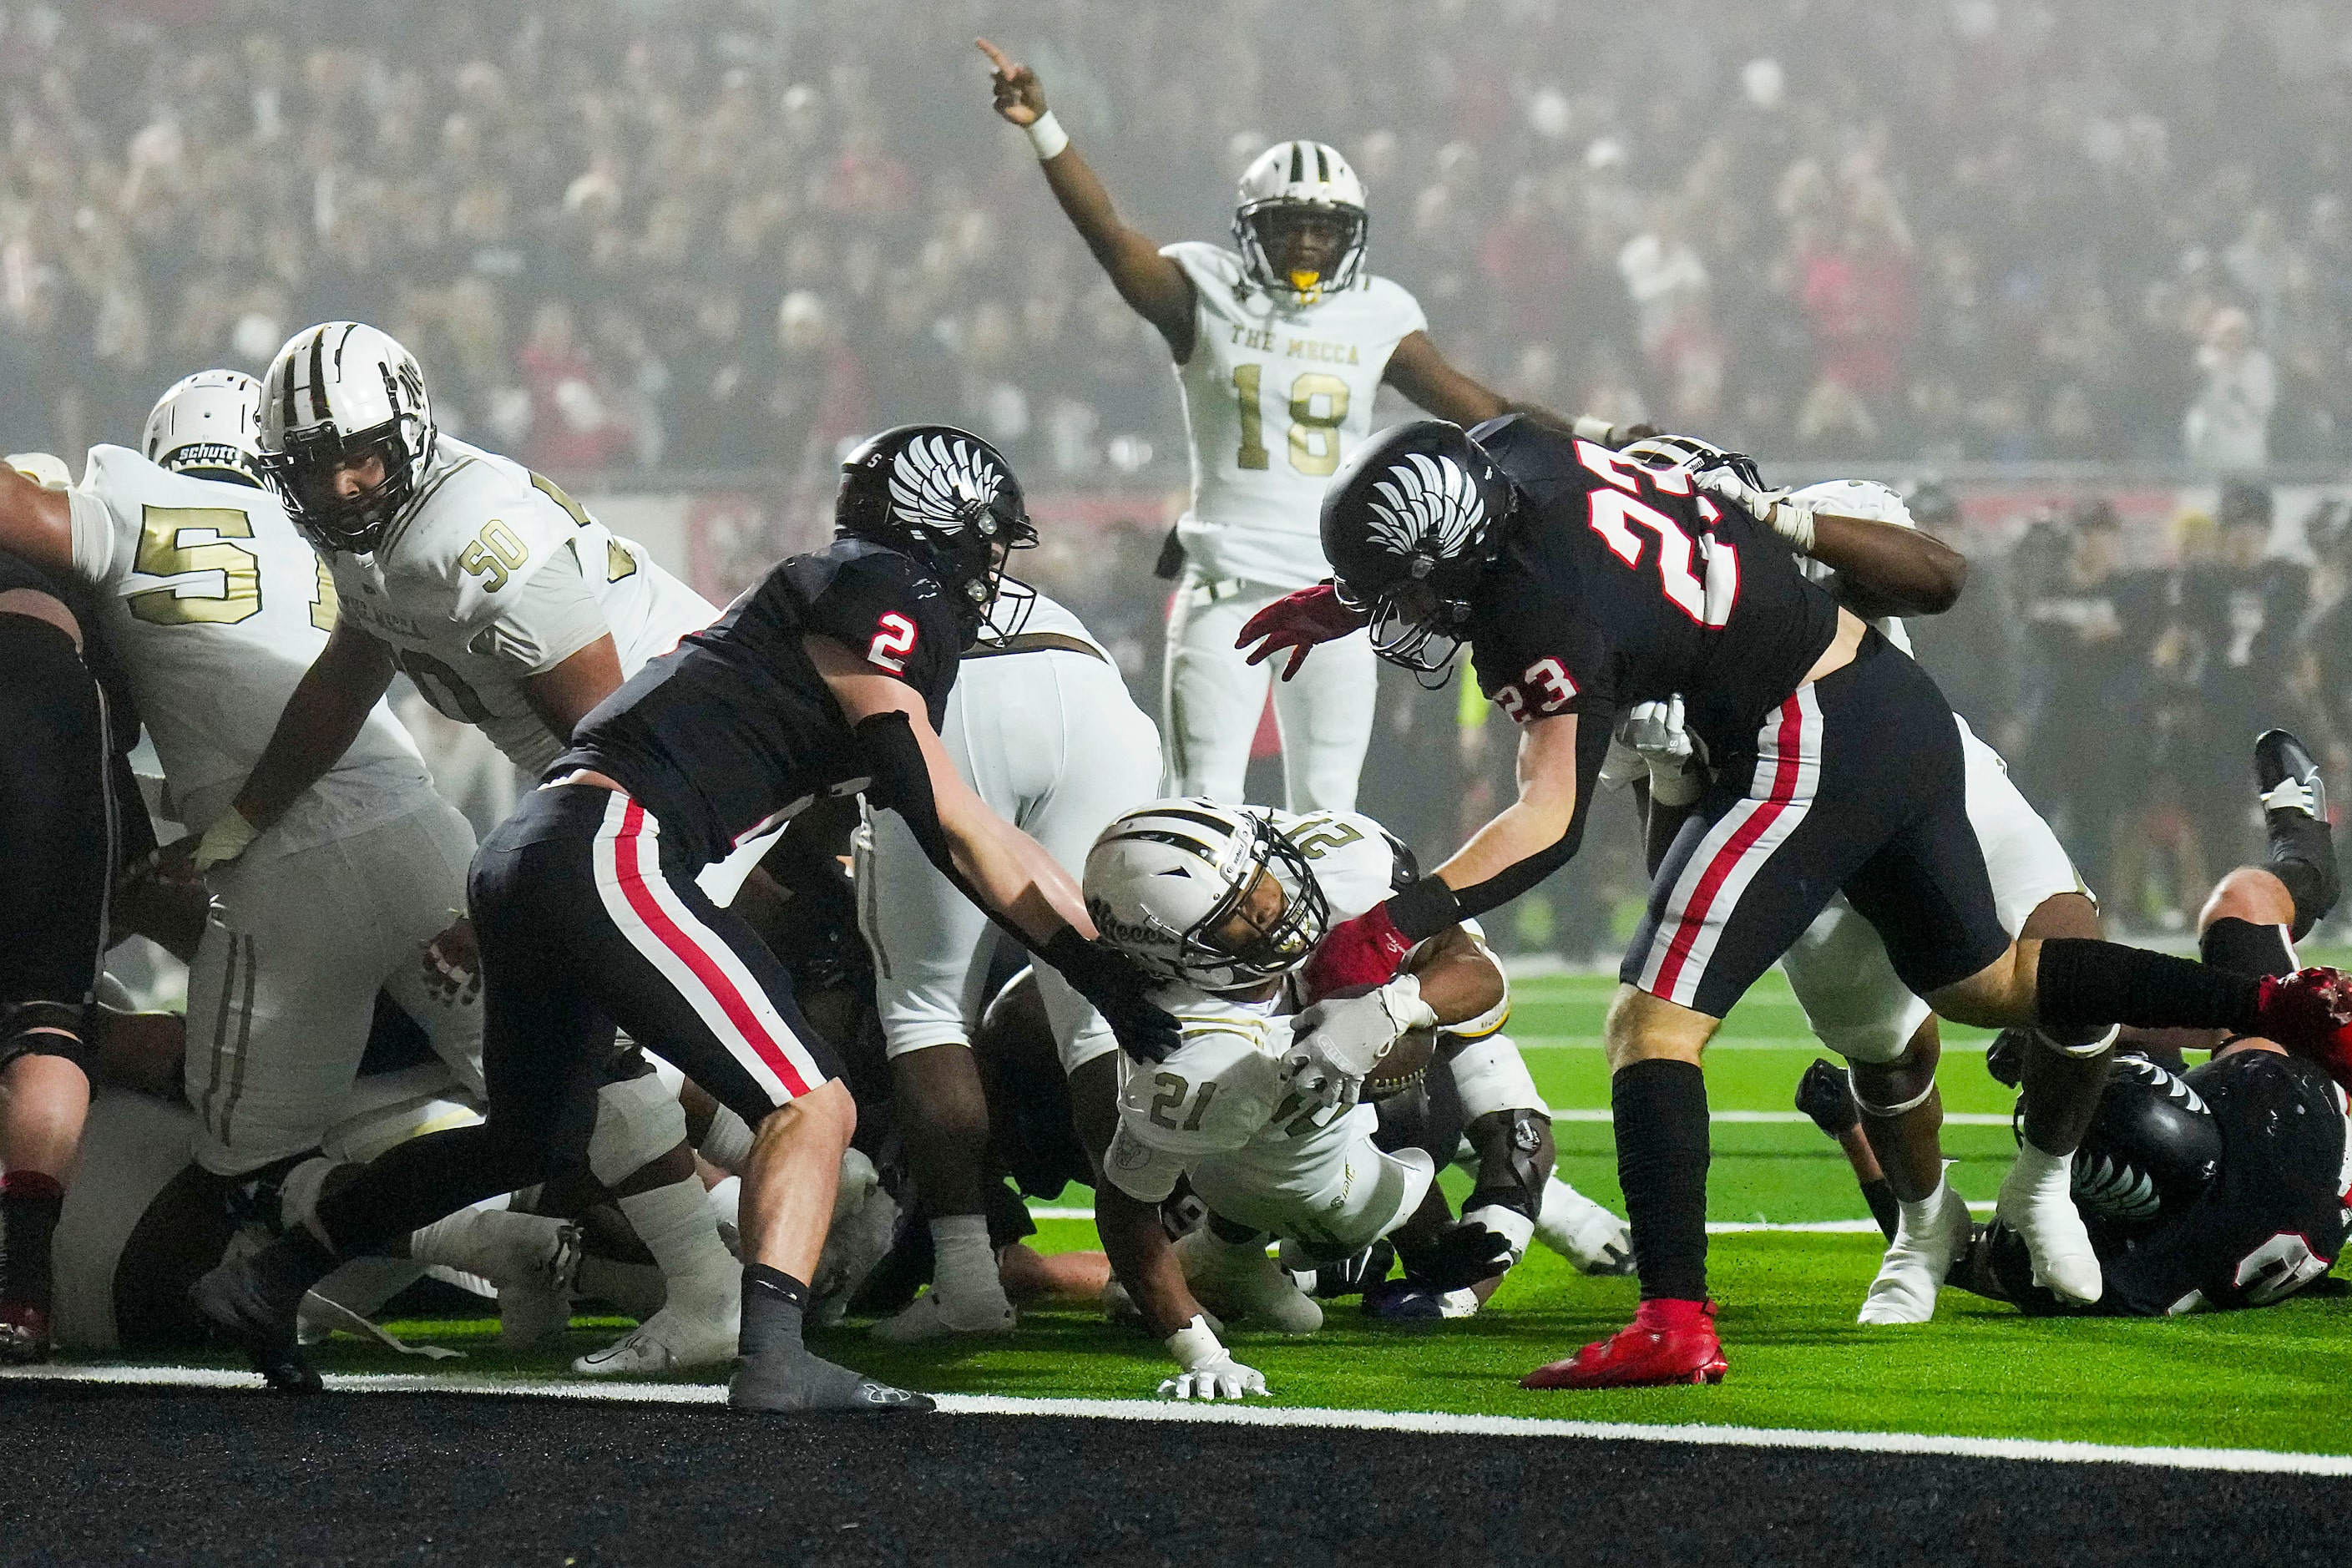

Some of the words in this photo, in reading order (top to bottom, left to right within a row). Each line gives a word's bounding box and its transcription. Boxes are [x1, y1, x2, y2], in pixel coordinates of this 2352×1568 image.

[1232, 324, 1276, 352] THE
[1287, 337, 1359, 366] MECCA
[178, 443, 237, 460] schutt
[1232, 363, 1351, 477] 18
[459, 518, 529, 594] 50
[1572, 438, 1741, 630] 23
[867, 610, 918, 676] 2
[1493, 655, 1581, 726] 23
[1150, 1072, 1217, 1131] 21
